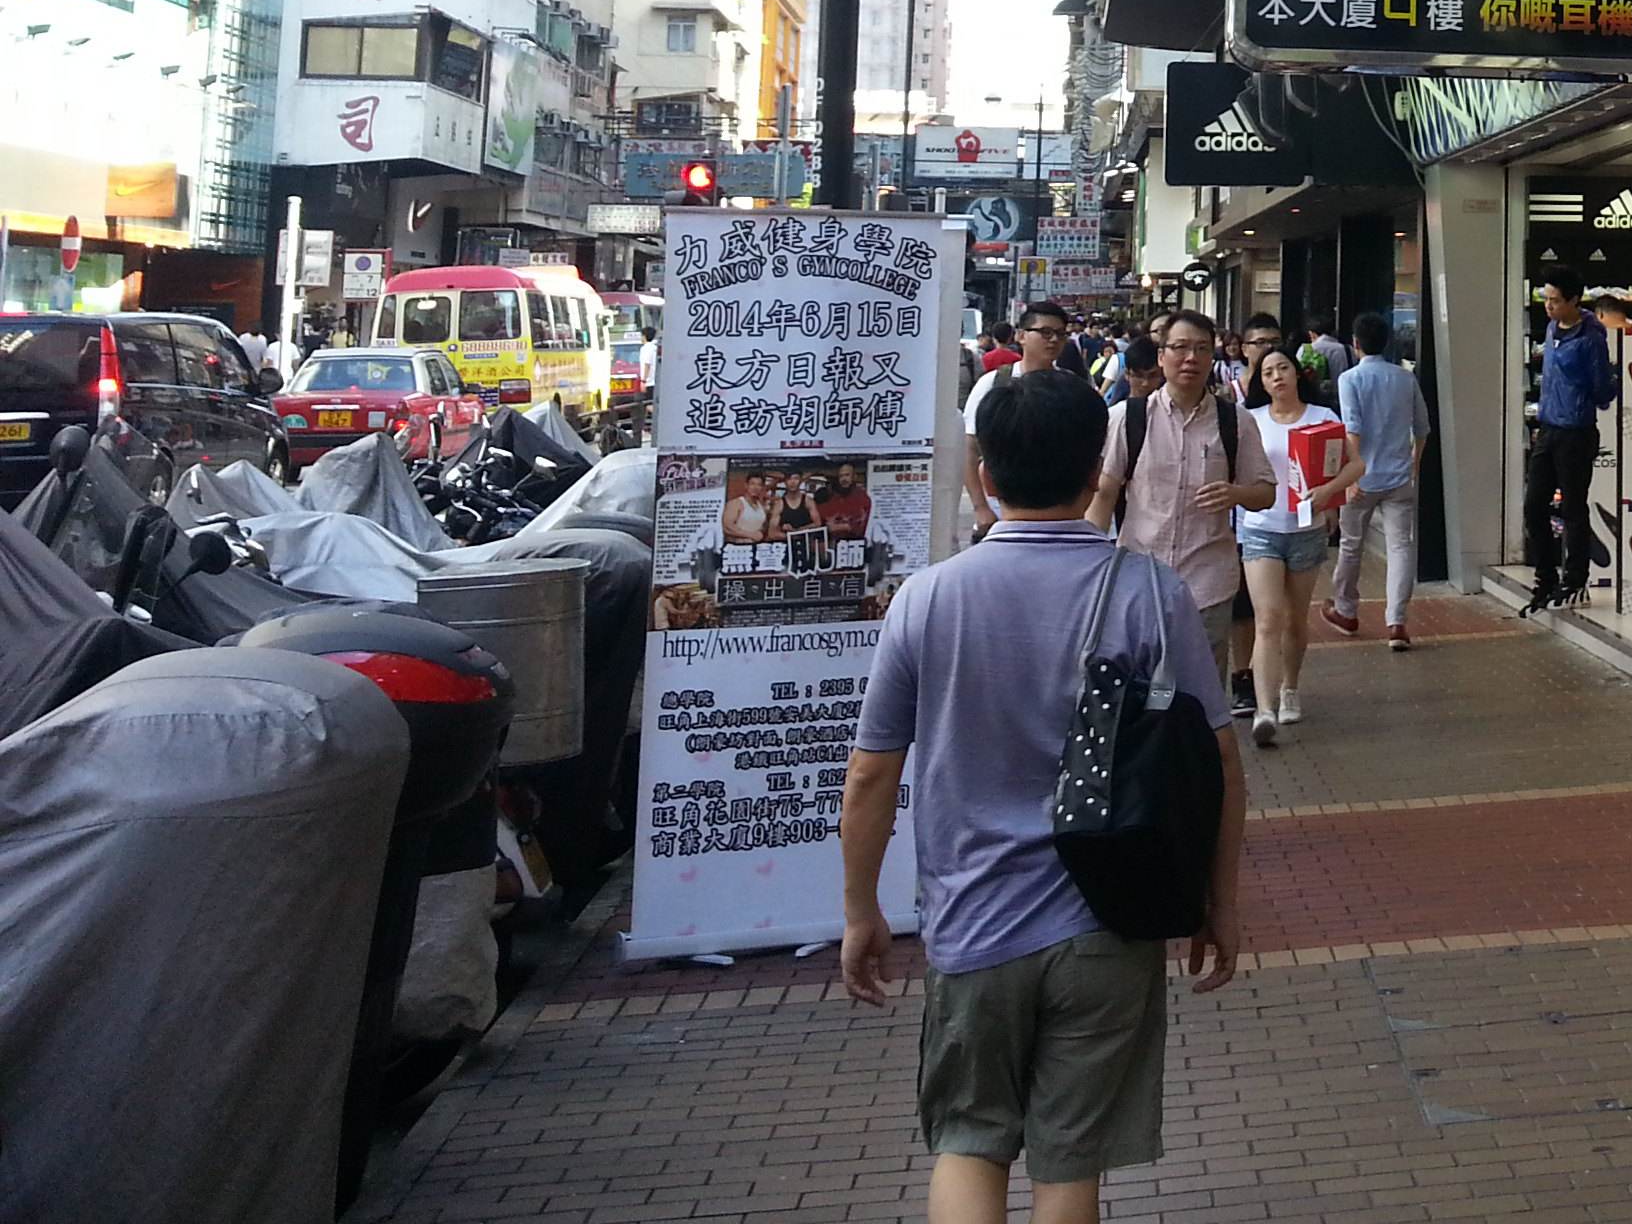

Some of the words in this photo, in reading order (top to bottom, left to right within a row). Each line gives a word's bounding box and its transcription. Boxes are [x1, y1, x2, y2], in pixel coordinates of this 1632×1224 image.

[1194, 131, 1277, 152] adida
[674, 216, 937, 280] 力威健身學院
[797, 254, 923, 302] GYMCOLLEGE
[687, 299, 923, 342] 2014年6月15日
[686, 345, 911, 396] 東方日報又
[683, 390, 907, 439] 追訪胡師傅
[651, 816, 842, 858] 商業大廈9樓903-
